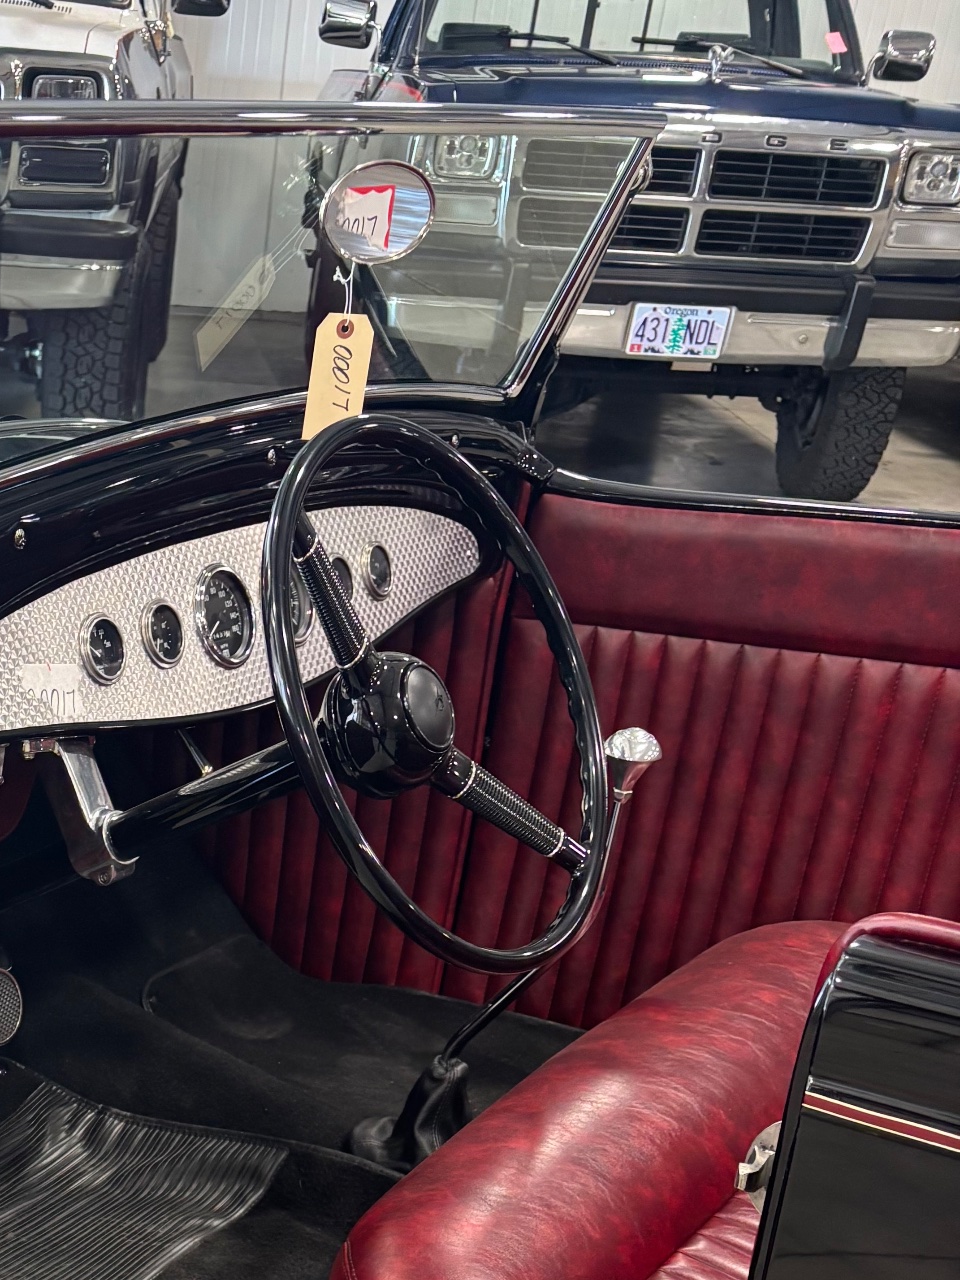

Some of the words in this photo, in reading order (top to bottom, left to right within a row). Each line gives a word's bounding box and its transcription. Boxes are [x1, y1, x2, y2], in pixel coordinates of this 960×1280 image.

[664, 306, 699, 317] Oregon
[635, 317, 670, 343] 431
[683, 319, 718, 346] NDL
[332, 344, 353, 412] 00017
